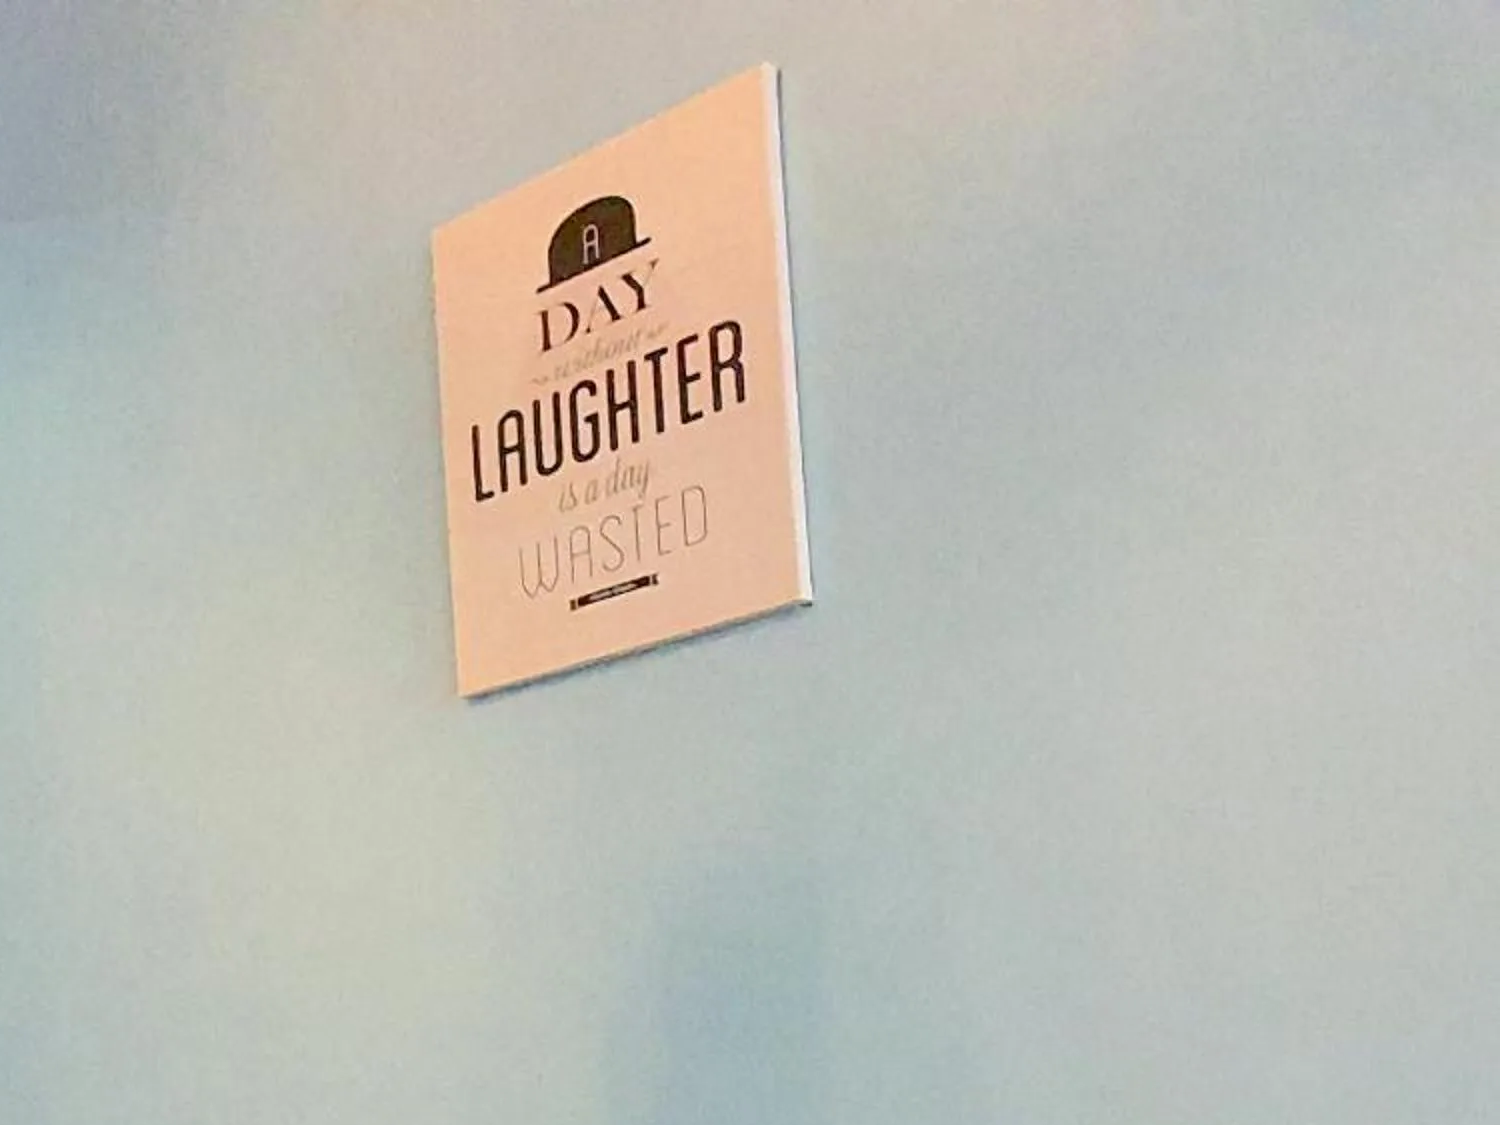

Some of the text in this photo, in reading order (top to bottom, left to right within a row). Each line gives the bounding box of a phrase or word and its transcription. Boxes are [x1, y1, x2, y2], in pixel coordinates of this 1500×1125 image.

[582, 223, 600, 265] A
[535, 258, 660, 356] DAY
[471, 320, 746, 502] LAUGHTER
[558, 457, 650, 513] is a day
[519, 485, 708, 599] WASTED
